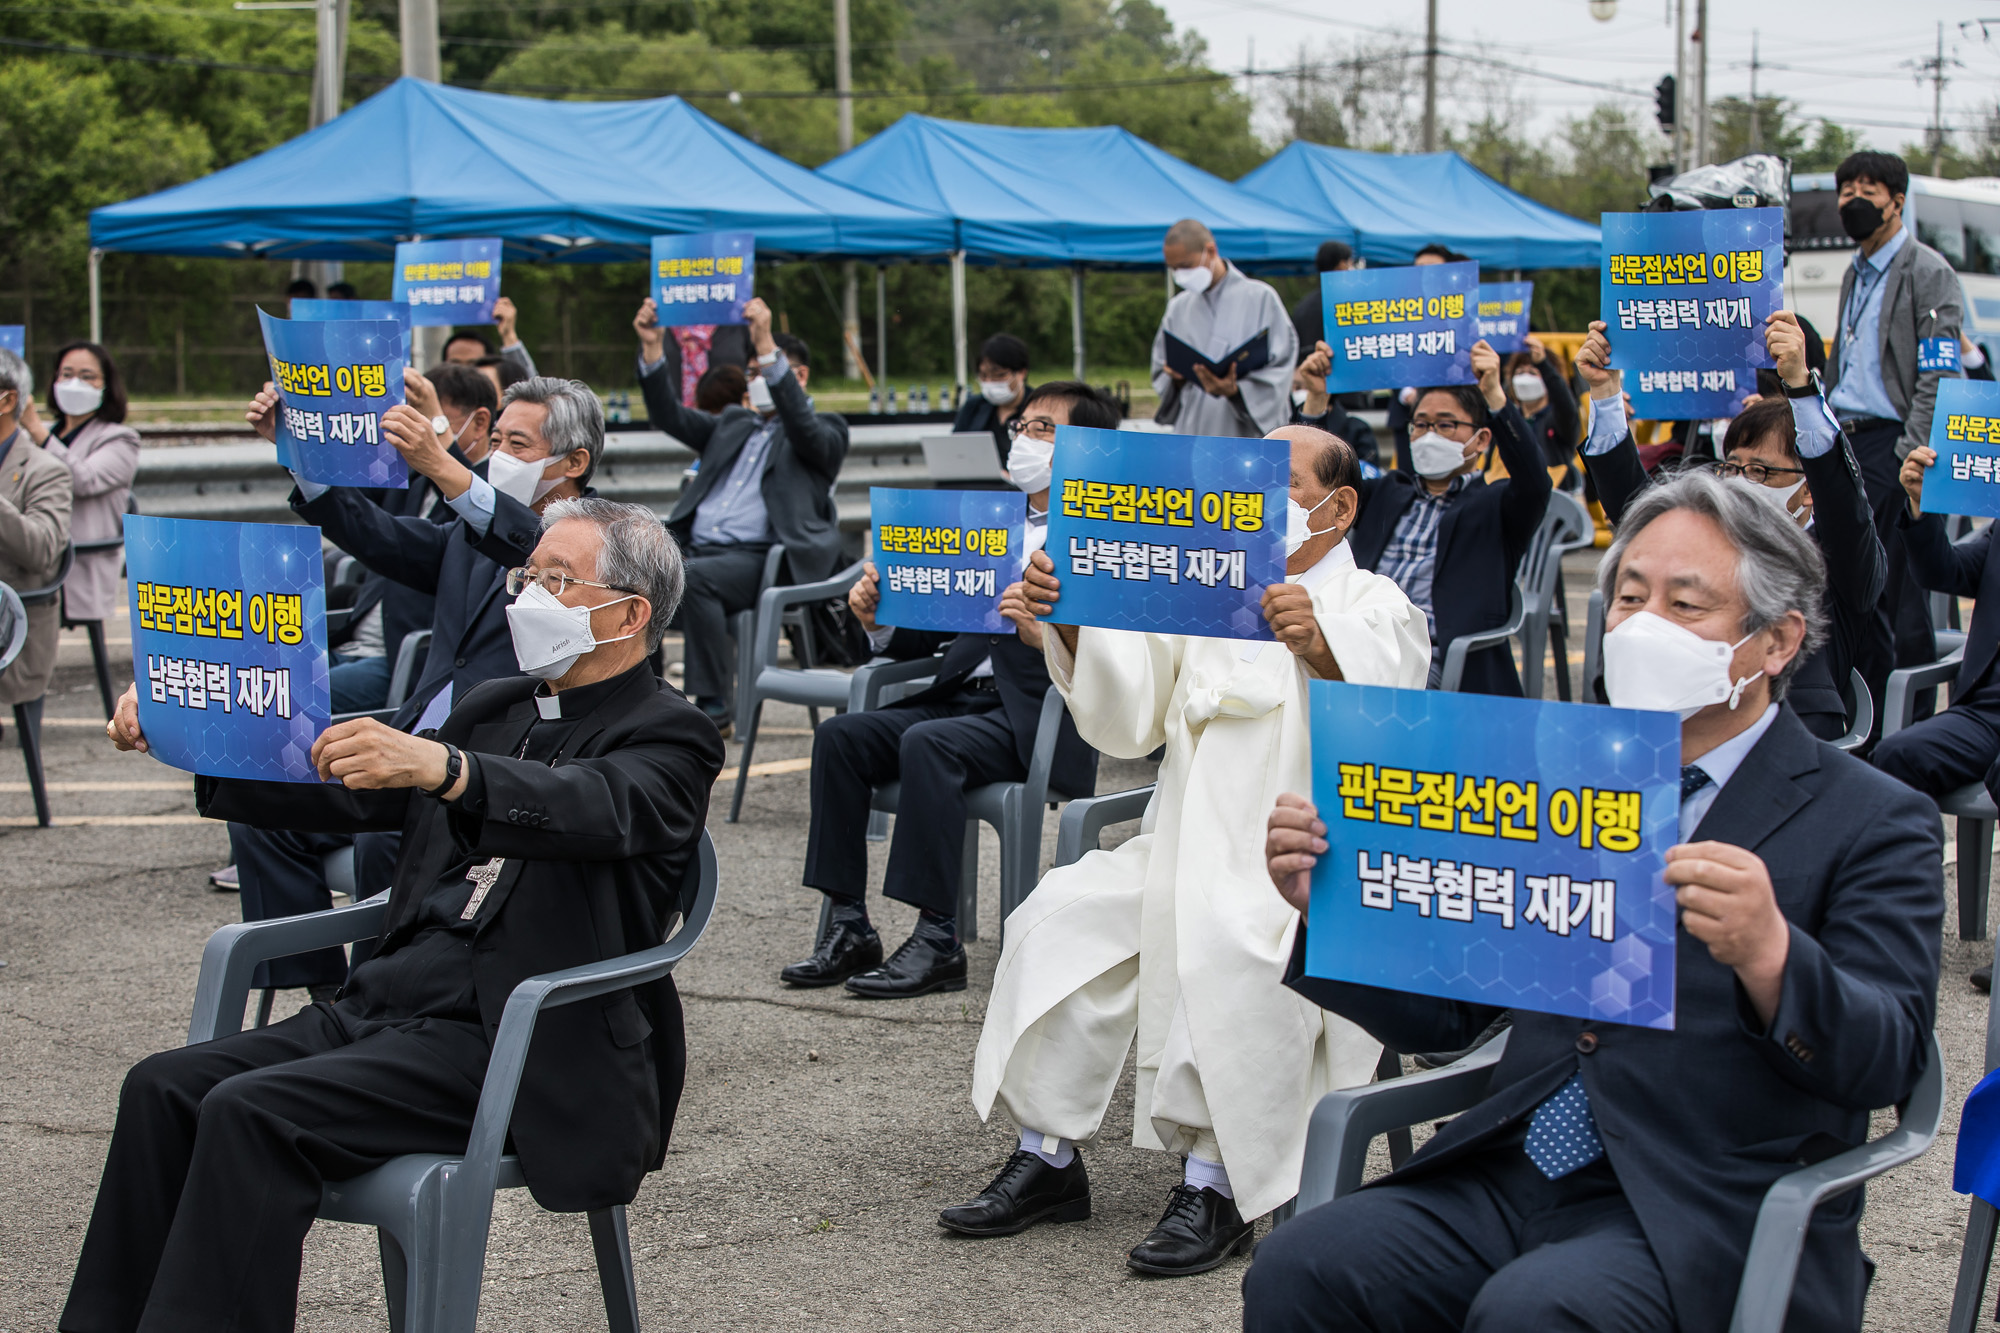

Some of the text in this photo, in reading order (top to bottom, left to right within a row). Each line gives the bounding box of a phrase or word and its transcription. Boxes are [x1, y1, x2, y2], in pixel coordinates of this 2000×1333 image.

[716, 256, 743, 276] 이행
[1610, 250, 1763, 285] 판문점선언 이행
[1334, 294, 1465, 326] 판문점선언 이행
[1618, 297, 1752, 330] 남북협력 재개
[1344, 329, 1455, 361] 남북협력 재개
[1918, 358, 1952, 368] RESS
[335, 364, 387, 398] 이행
[1639, 369, 1735, 392] 남북협력 재개
[283, 405, 379, 445] 북협력 재개
[1061, 478, 1265, 532] 판문점선언 이행
[879, 524, 1008, 557] 판문점선언 이행
[1069, 537, 1247, 590] 남북협력 재개
[887, 564, 996, 597] 남북협력 재개
[137, 581, 304, 645] 판문점선언 이행
[552, 638, 571, 654] Airish
[148, 654, 291, 720] 남북협력 재개
[1338, 761, 1642, 852] 판문점선언 이행
[1357, 849, 1616, 942] 남북협력 재개
